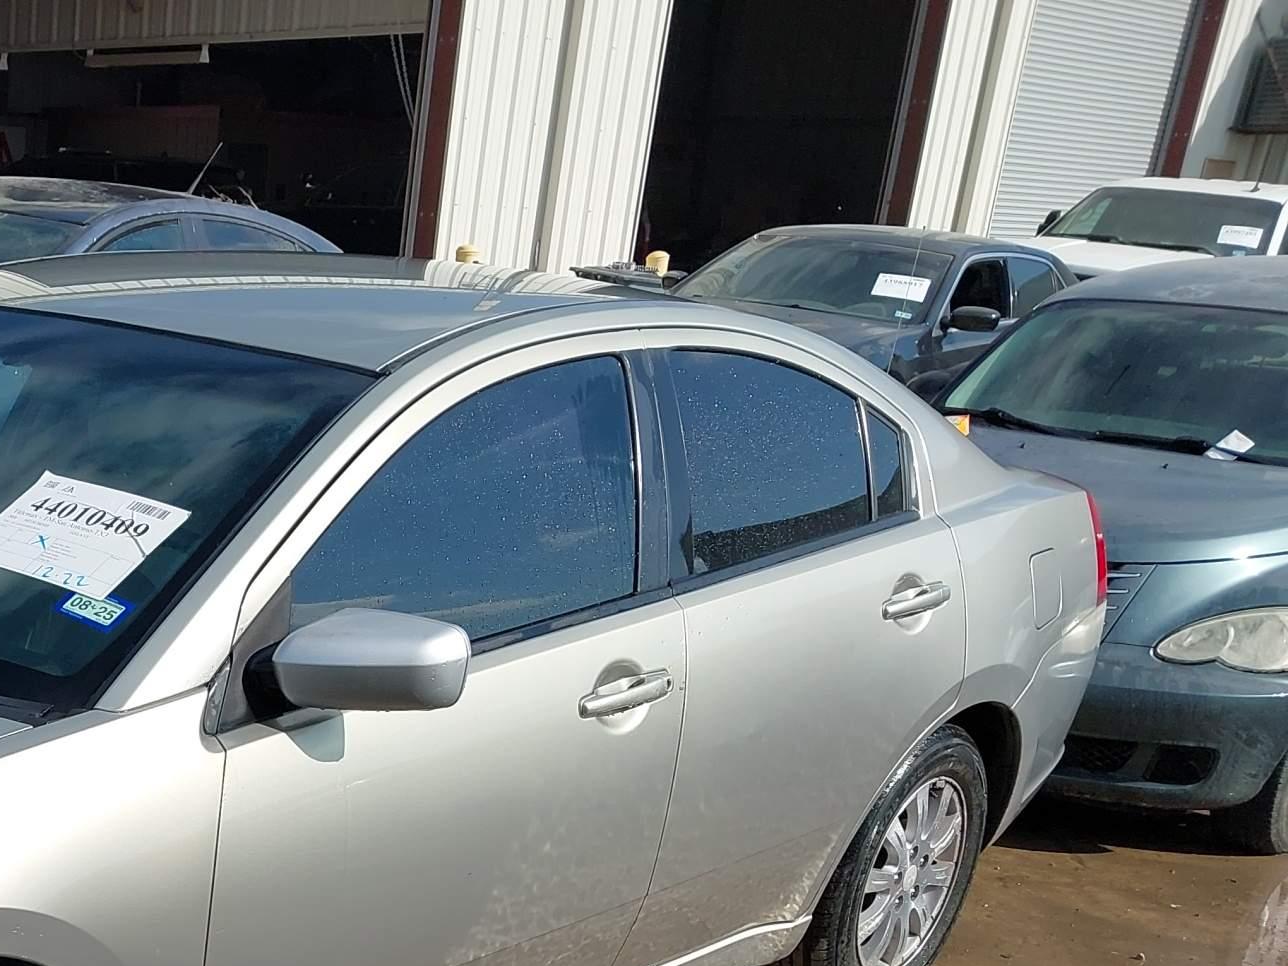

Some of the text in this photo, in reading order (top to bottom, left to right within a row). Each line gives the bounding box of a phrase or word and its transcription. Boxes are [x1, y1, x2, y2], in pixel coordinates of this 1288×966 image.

[31, 497, 150, 539] 44010409
[70, 597, 92, 611] 08
[93, 606, 117, 621] 25
